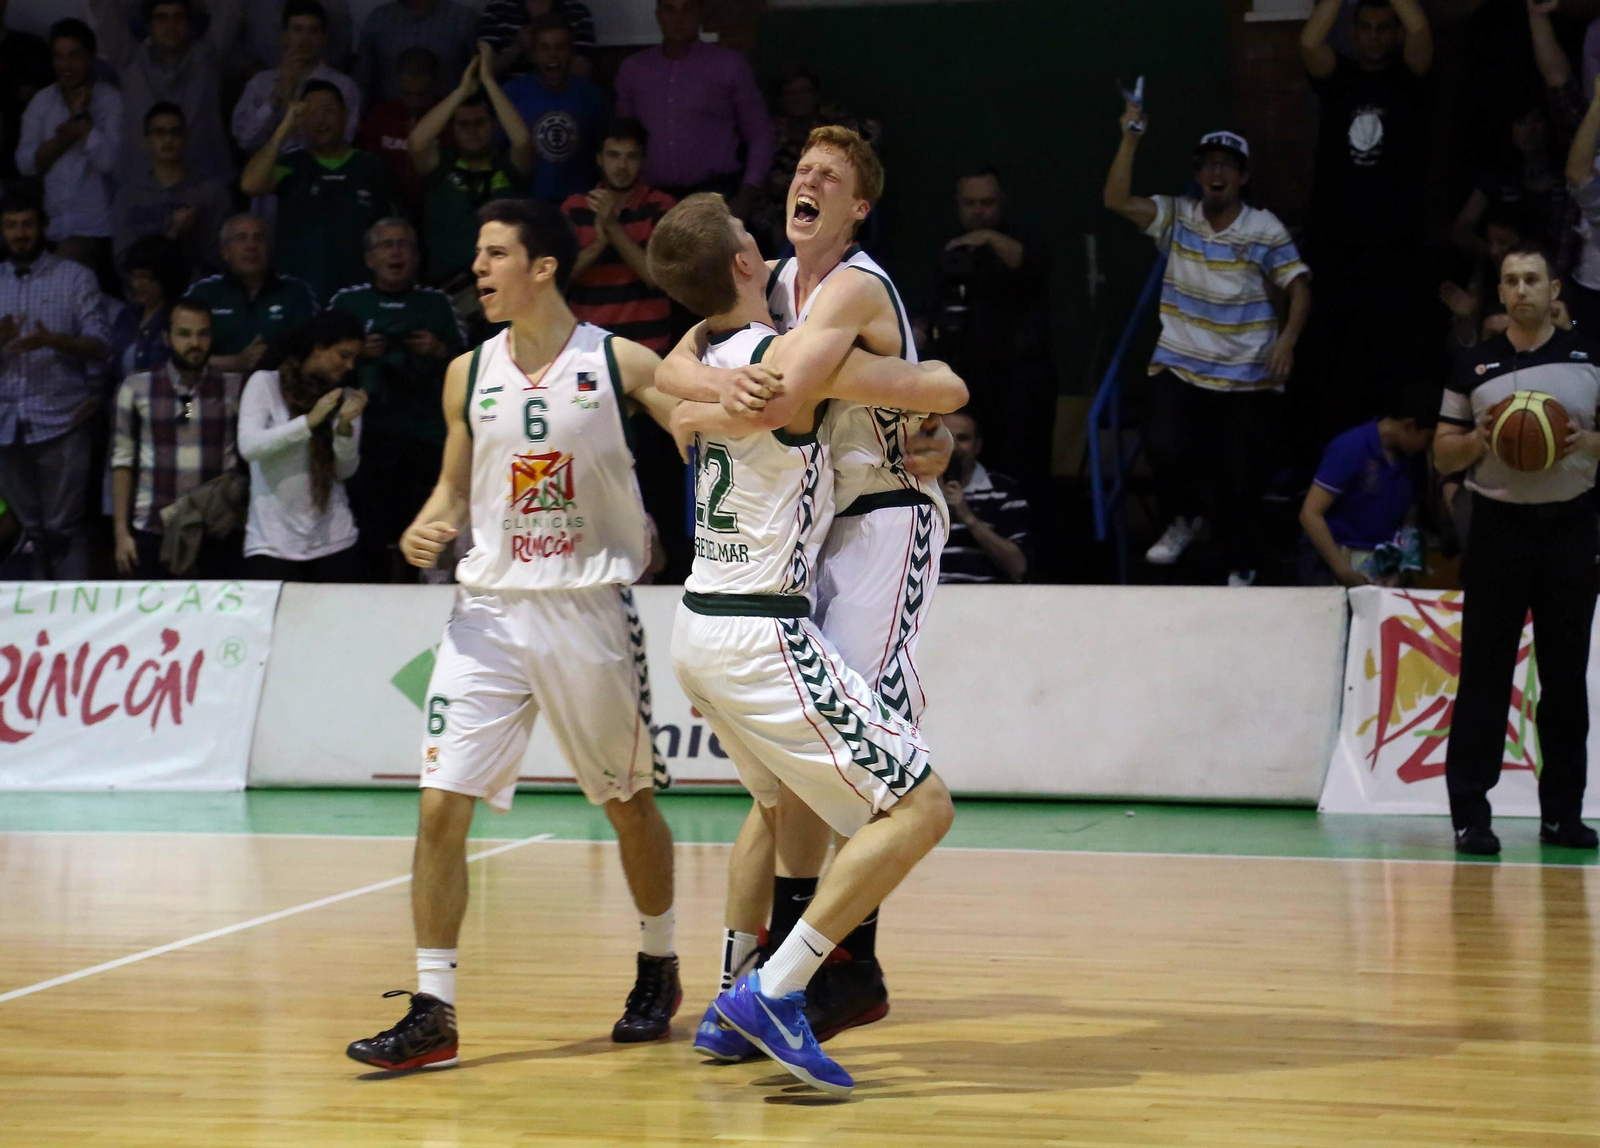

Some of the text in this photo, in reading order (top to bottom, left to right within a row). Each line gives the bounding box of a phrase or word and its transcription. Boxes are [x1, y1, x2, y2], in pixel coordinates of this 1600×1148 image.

[523, 396, 549, 443] 6
[0, 581, 245, 614] LINICAS
[427, 692, 451, 738] 6
